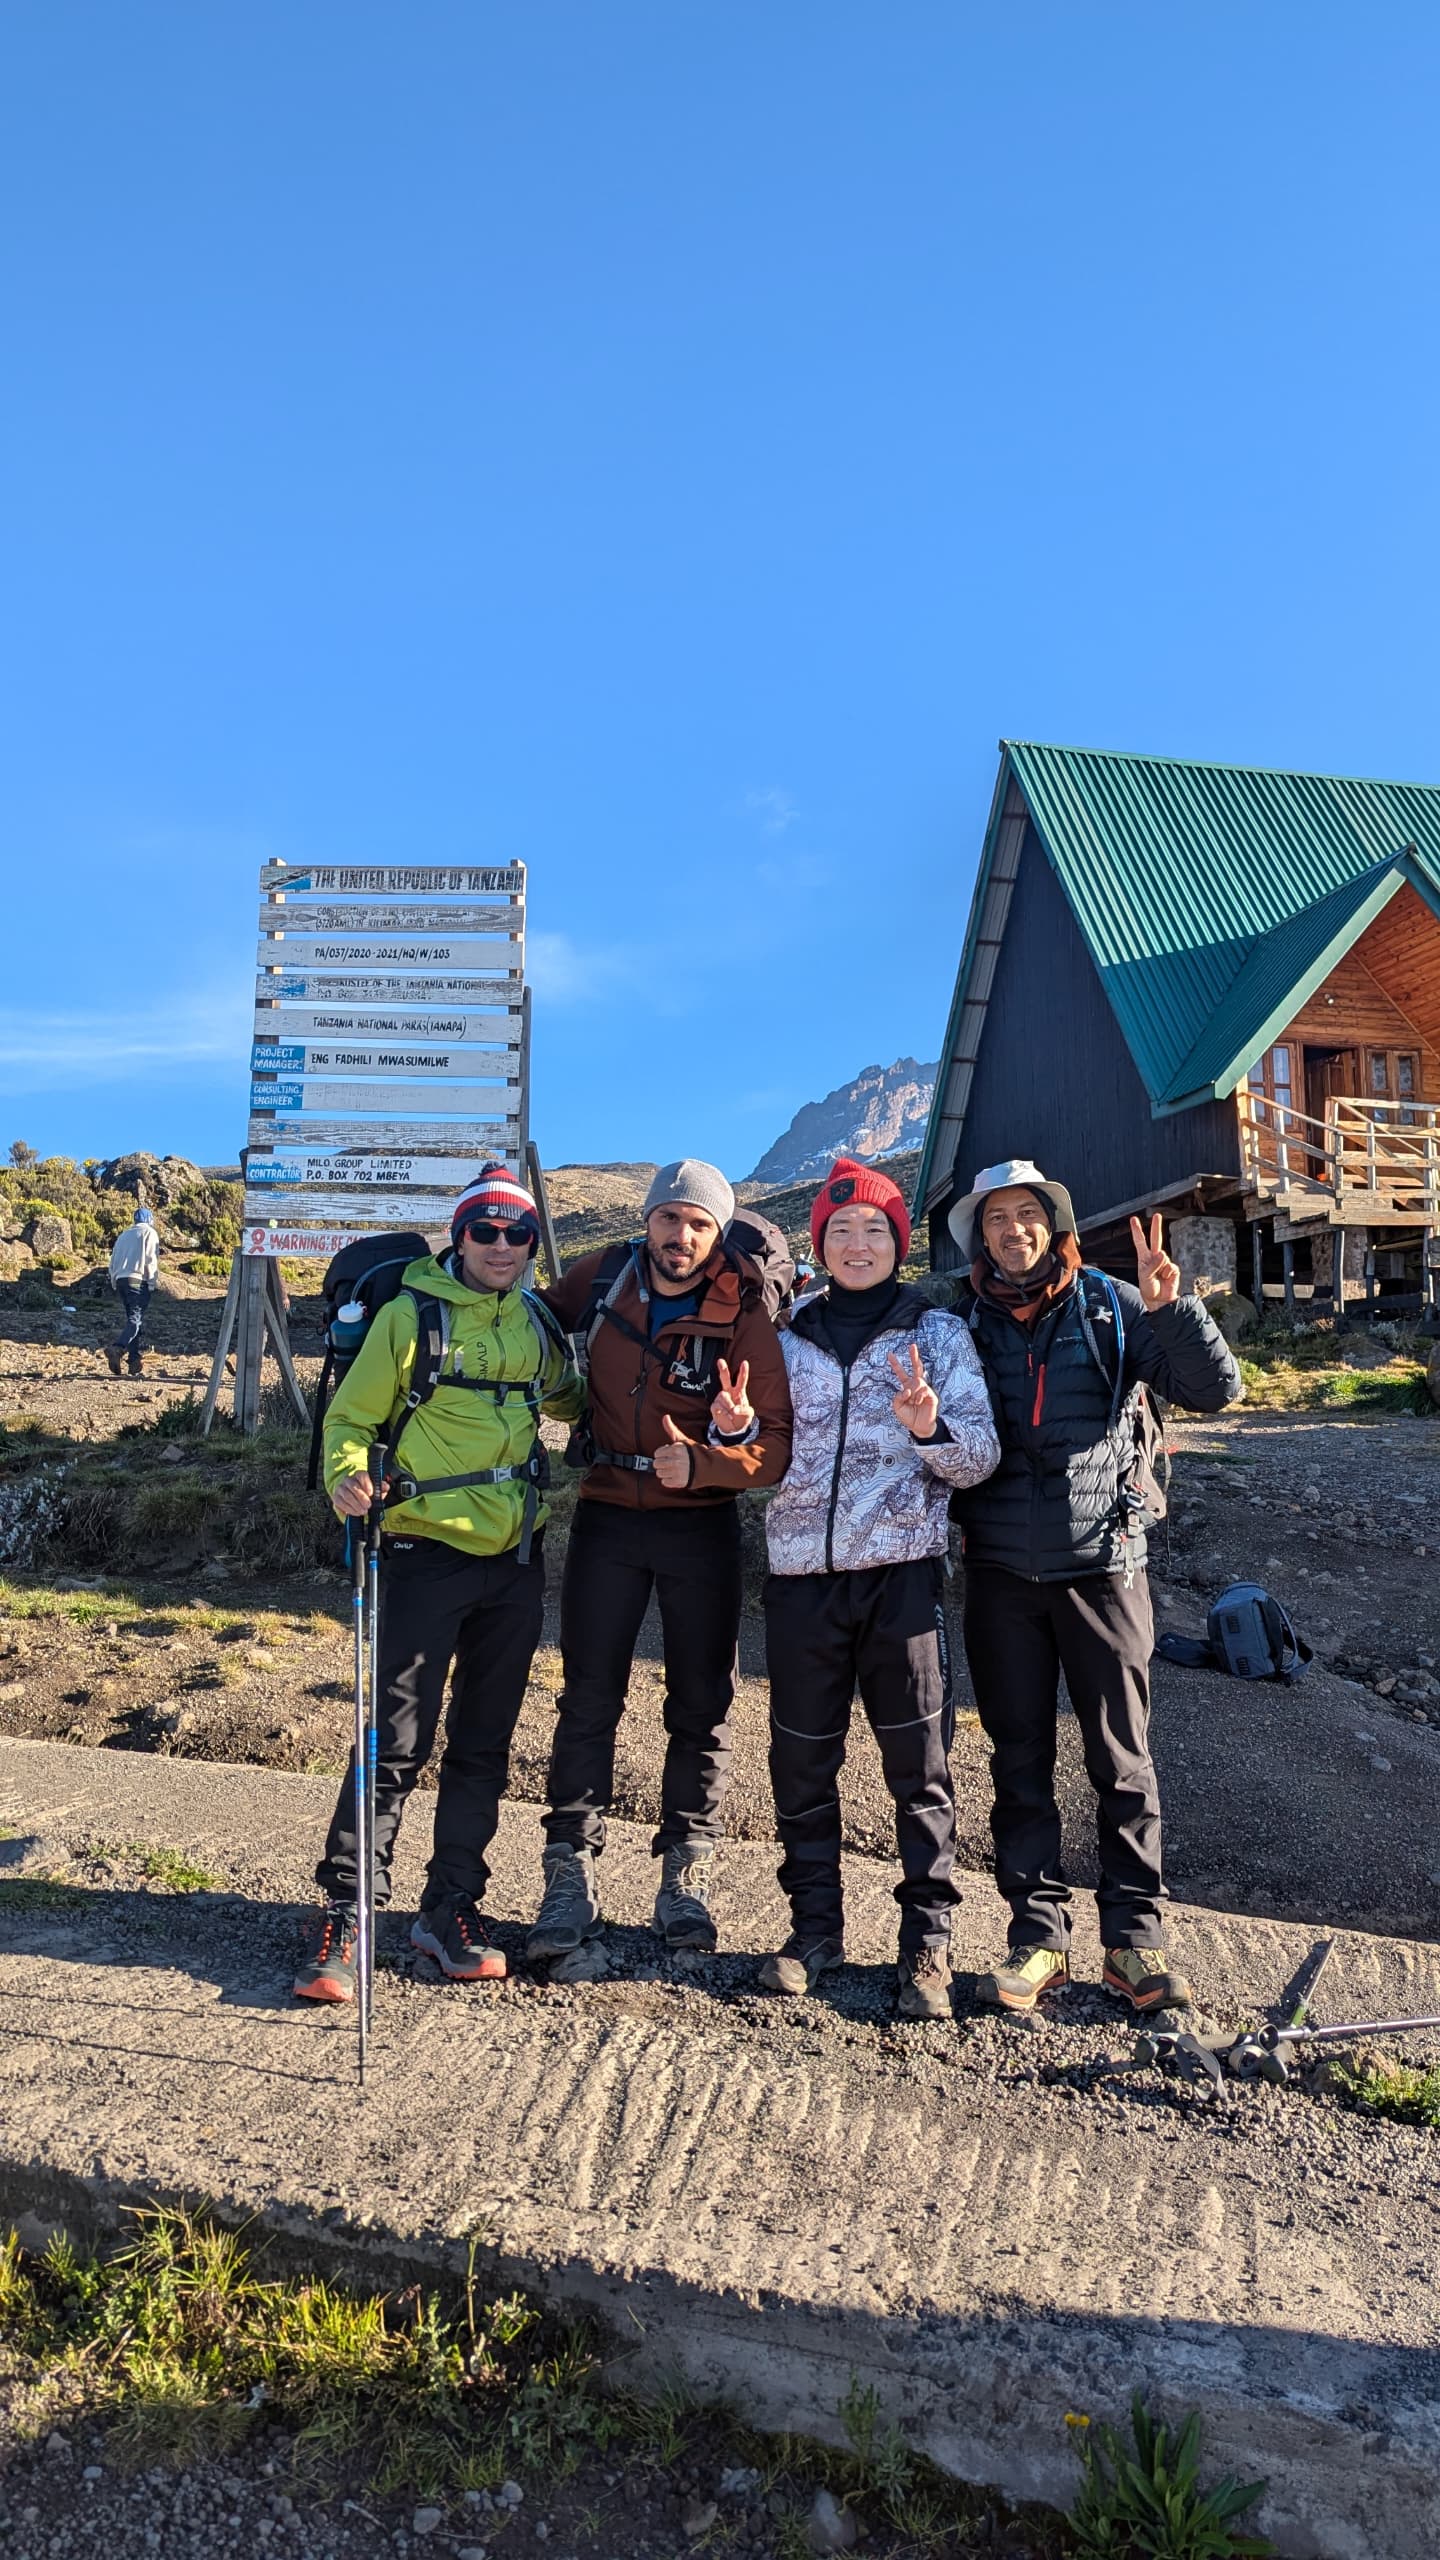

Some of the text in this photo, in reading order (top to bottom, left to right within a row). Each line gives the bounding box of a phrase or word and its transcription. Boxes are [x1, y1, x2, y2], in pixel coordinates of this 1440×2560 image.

[315, 869, 523, 891] THE UNITED REPUBLIC OF TANZANIA
[387, 979, 400, 989] THE
[314, 1017, 353, 1029] TANZANIA
[357, 1018, 398, 1030] NATIONAL
[255, 1047, 295, 1058] PROJECT
[311, 1053, 450, 1068] ENG FADHILI MWASUMILWE
[254, 1085, 300, 1095] CONSULTING
[253, 1095, 294, 1107] ENGINEER
[307, 1158, 412, 1169] MILO GROUP LIMITED
[249, 1168, 301, 1179] CONTRACTOR
[306, 1171, 410, 1181] P.O. BOX 702 MBEYA
[331, 1236, 344, 1251] BE
